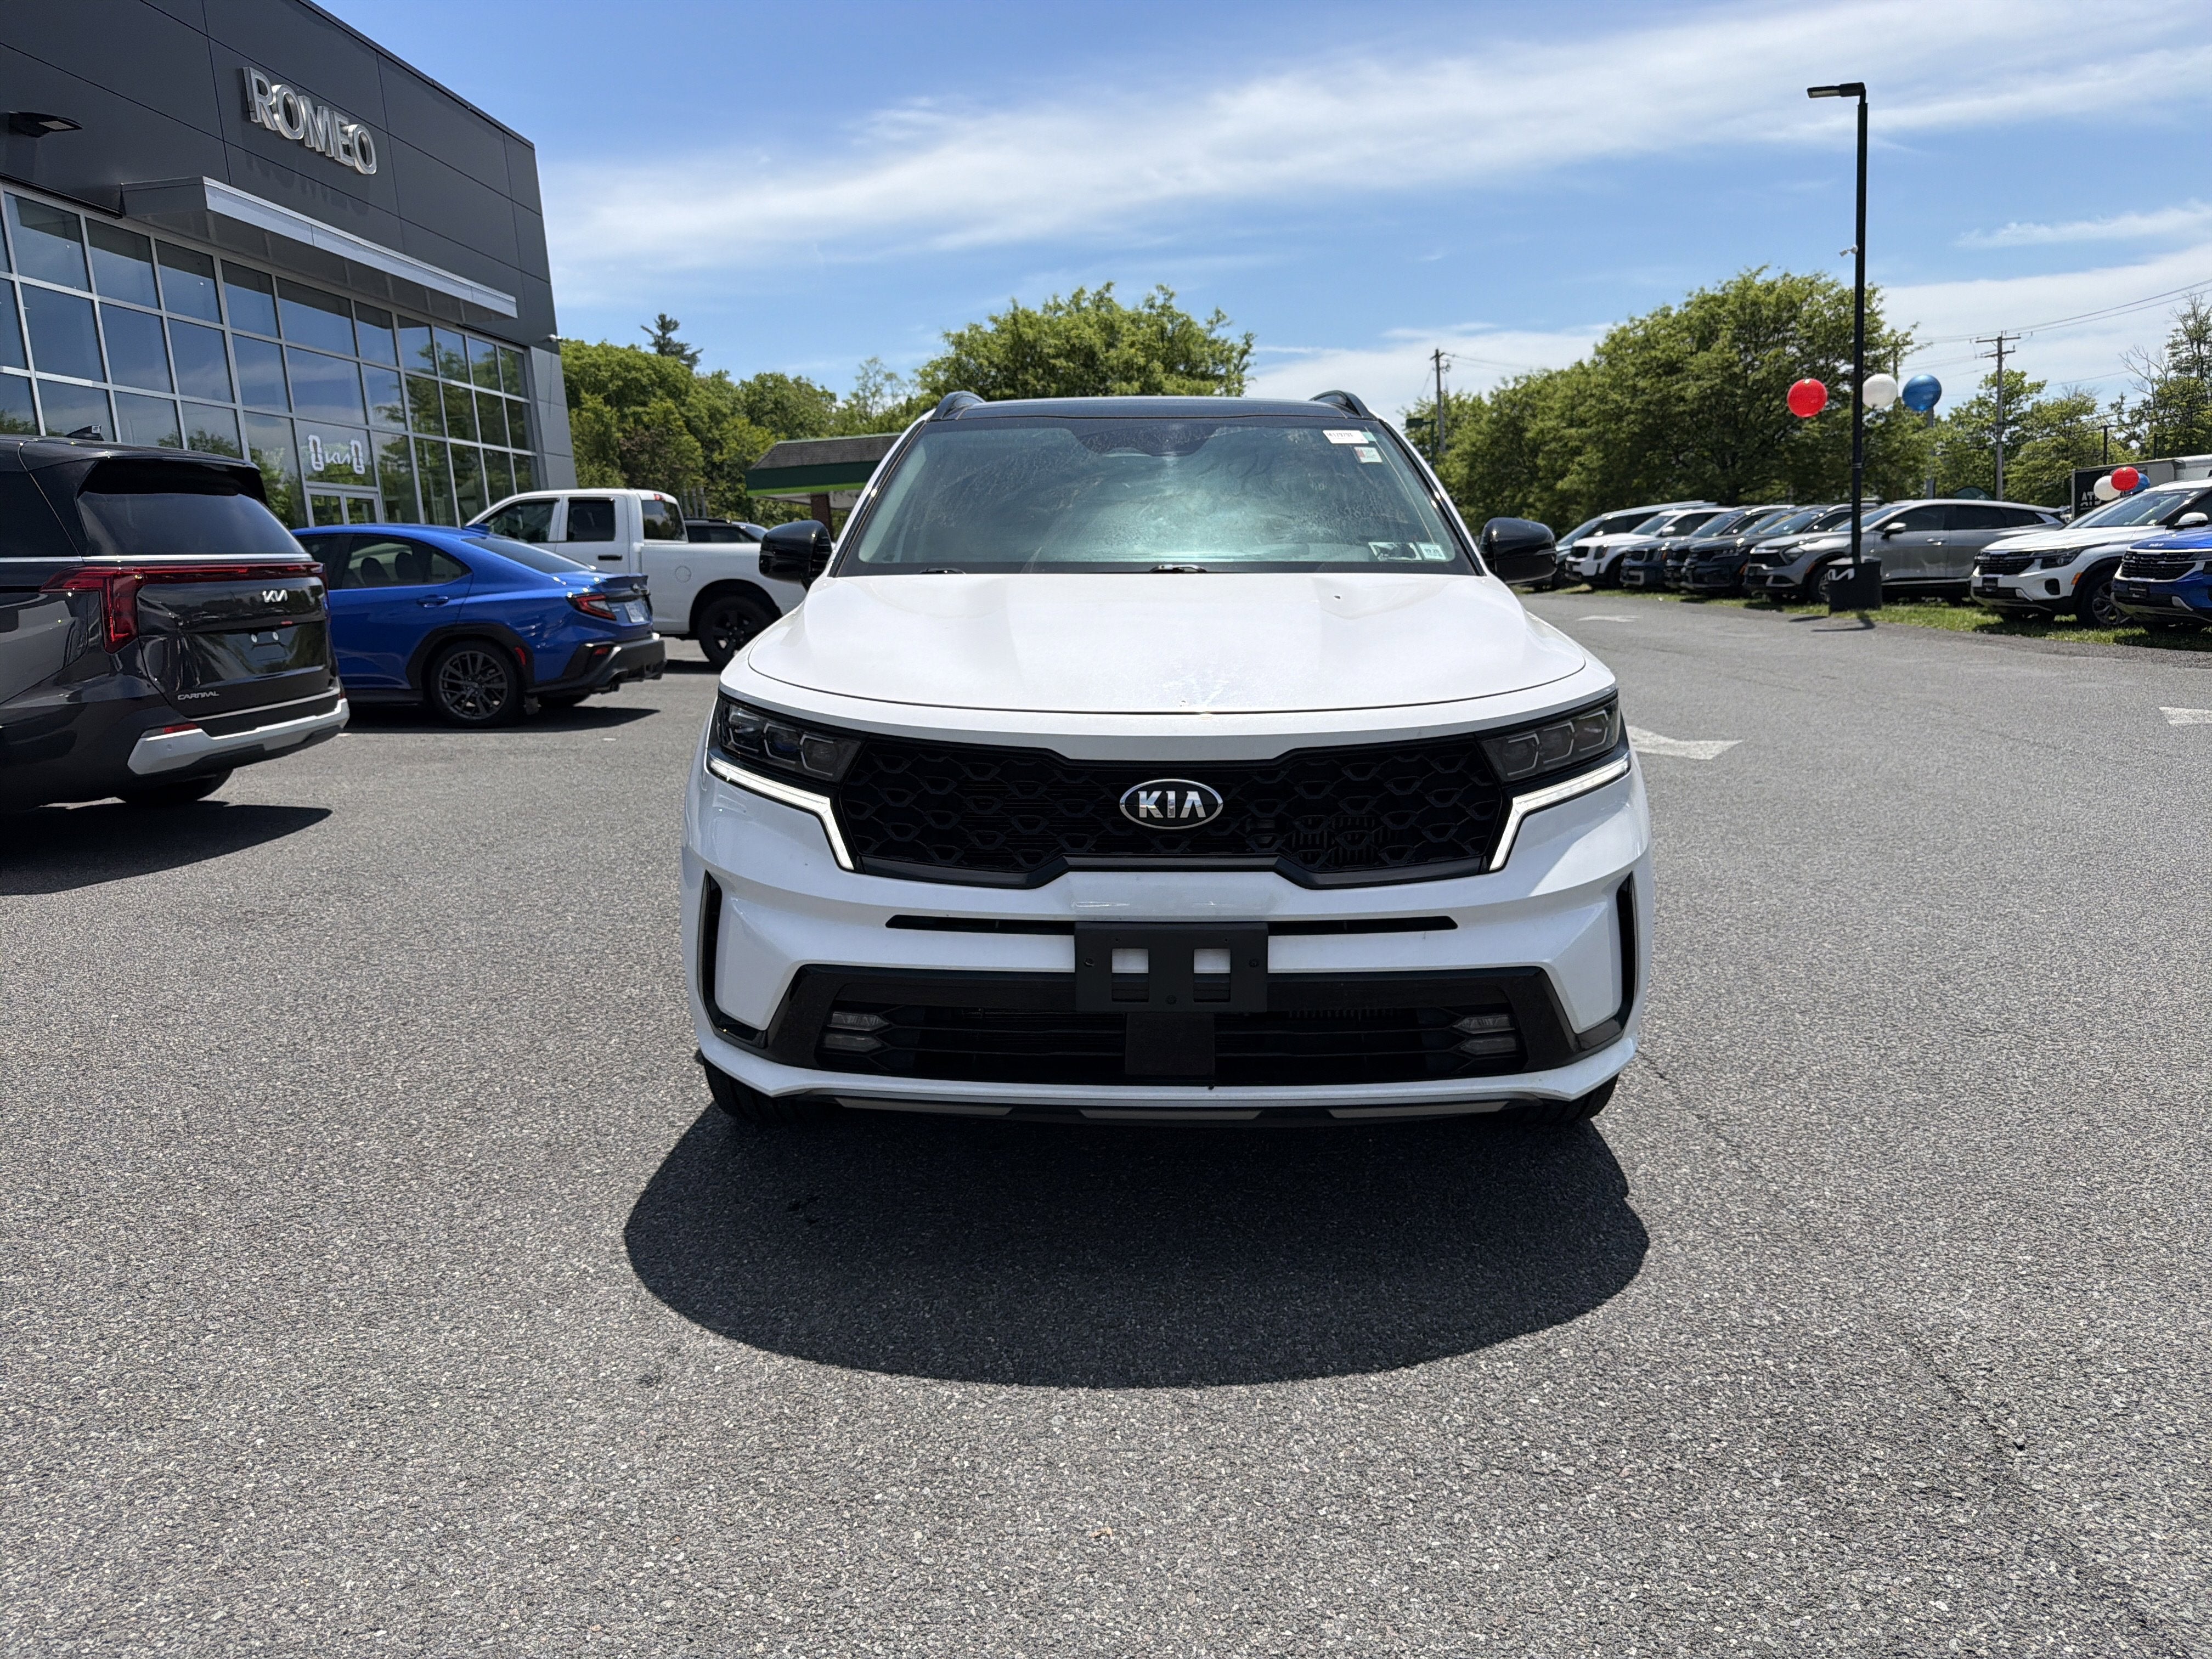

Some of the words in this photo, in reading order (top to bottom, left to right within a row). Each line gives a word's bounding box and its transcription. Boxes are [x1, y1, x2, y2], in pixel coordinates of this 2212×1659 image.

[243, 66, 377, 174] ROMEO
[262, 589, 288, 603] KIA
[177, 691, 220, 701] CARNIVAL
[1137, 791, 1206, 818] KIA
